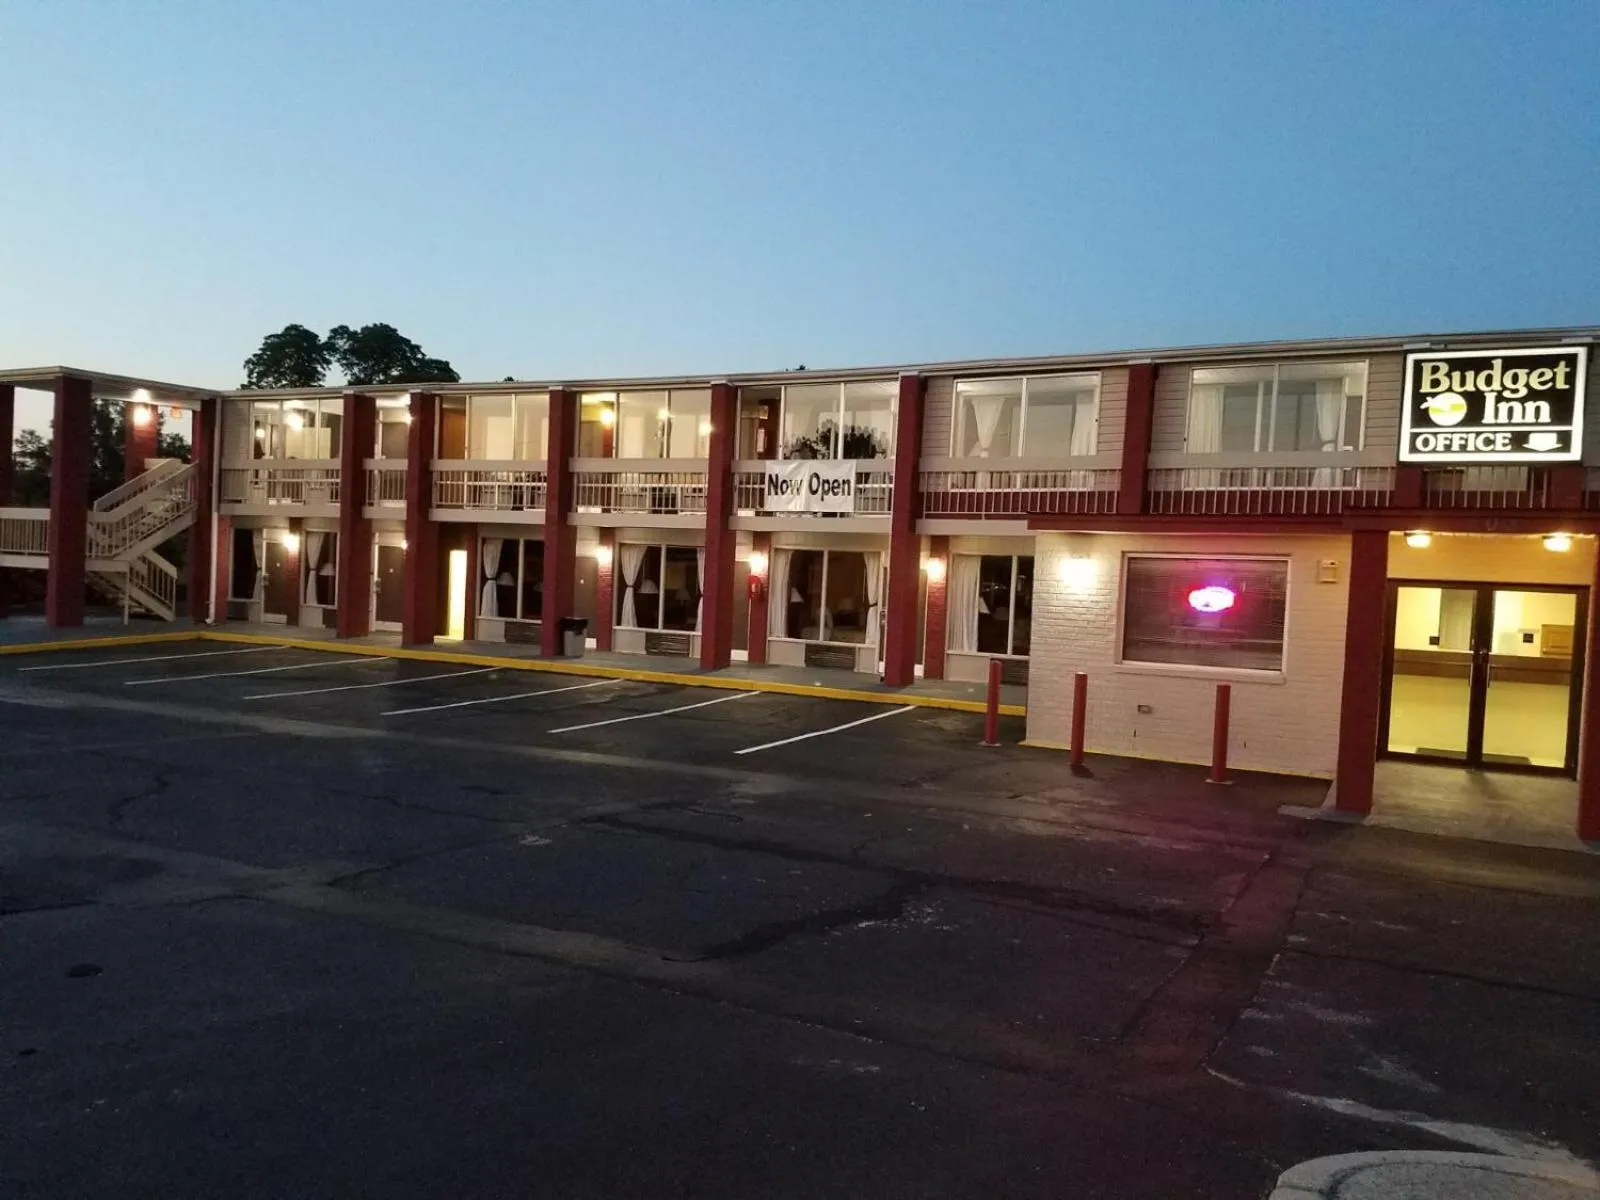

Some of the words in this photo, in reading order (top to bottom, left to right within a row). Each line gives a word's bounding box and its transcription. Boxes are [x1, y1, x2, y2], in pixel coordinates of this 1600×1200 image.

[1419, 359, 1571, 398] Budget
[1481, 392, 1551, 424] Inn
[1415, 432, 1512, 451] OFFICE
[767, 473, 803, 496] Now
[808, 472, 851, 501] Open
